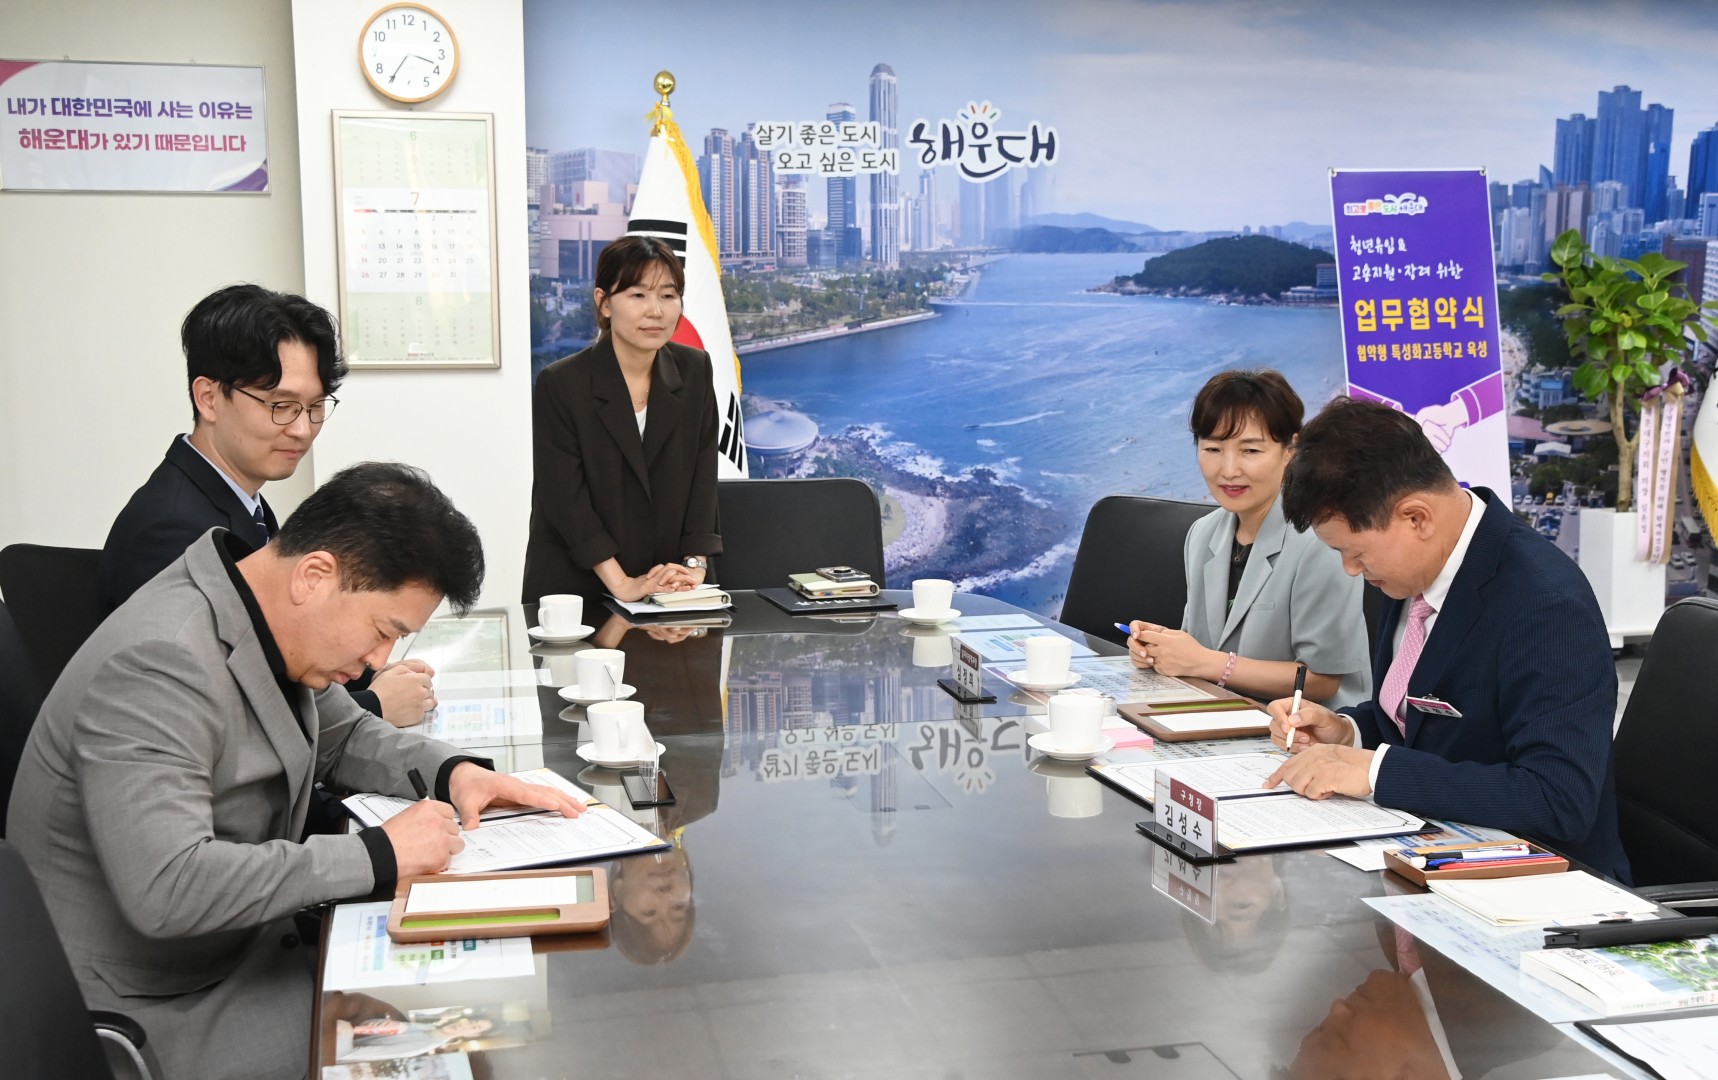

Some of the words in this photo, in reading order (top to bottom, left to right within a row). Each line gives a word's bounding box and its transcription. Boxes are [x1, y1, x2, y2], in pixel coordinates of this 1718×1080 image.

[386, 19, 396, 30] 11
[402, 14, 415, 26] 12
[422, 20, 427, 31] 1
[374, 31, 386, 42] 10
[433, 31, 440, 42] 2
[438, 48, 445, 60] 3
[376, 63, 383, 74] 8
[433, 65, 440, 76] 4
[424, 76, 430, 87] 5
[7, 98, 47, 116] 내가
[51, 97, 152, 118] 대한민국에
[157, 101, 193, 119] 사는
[199, 101, 253, 120] 이유는
[18, 128, 109, 150] 해운대가
[113, 133, 150, 151] 있기
[154, 133, 247, 152] 때문입니다
[756, 125, 793, 146] 살기
[800, 124, 836, 146] 좋은
[841, 125, 877, 144] 도시
[909, 122, 1056, 178] 해운대
[777, 153, 812, 170] 오고
[819, 152, 855, 173] 싶은
[861, 152, 896, 171] 도시
[410, 192, 420, 206] 7
[1436, 259, 1464, 280] 위한
[1354, 295, 1485, 332] 업무협약식
[1357, 344, 1388, 362] 협약형
[1391, 342, 1463, 361] 특성화고등학교
[1466, 340, 1488, 358] 육성
[1180, 789, 1203, 812] 구청장
[1164, 804, 1202, 840] 김성수
